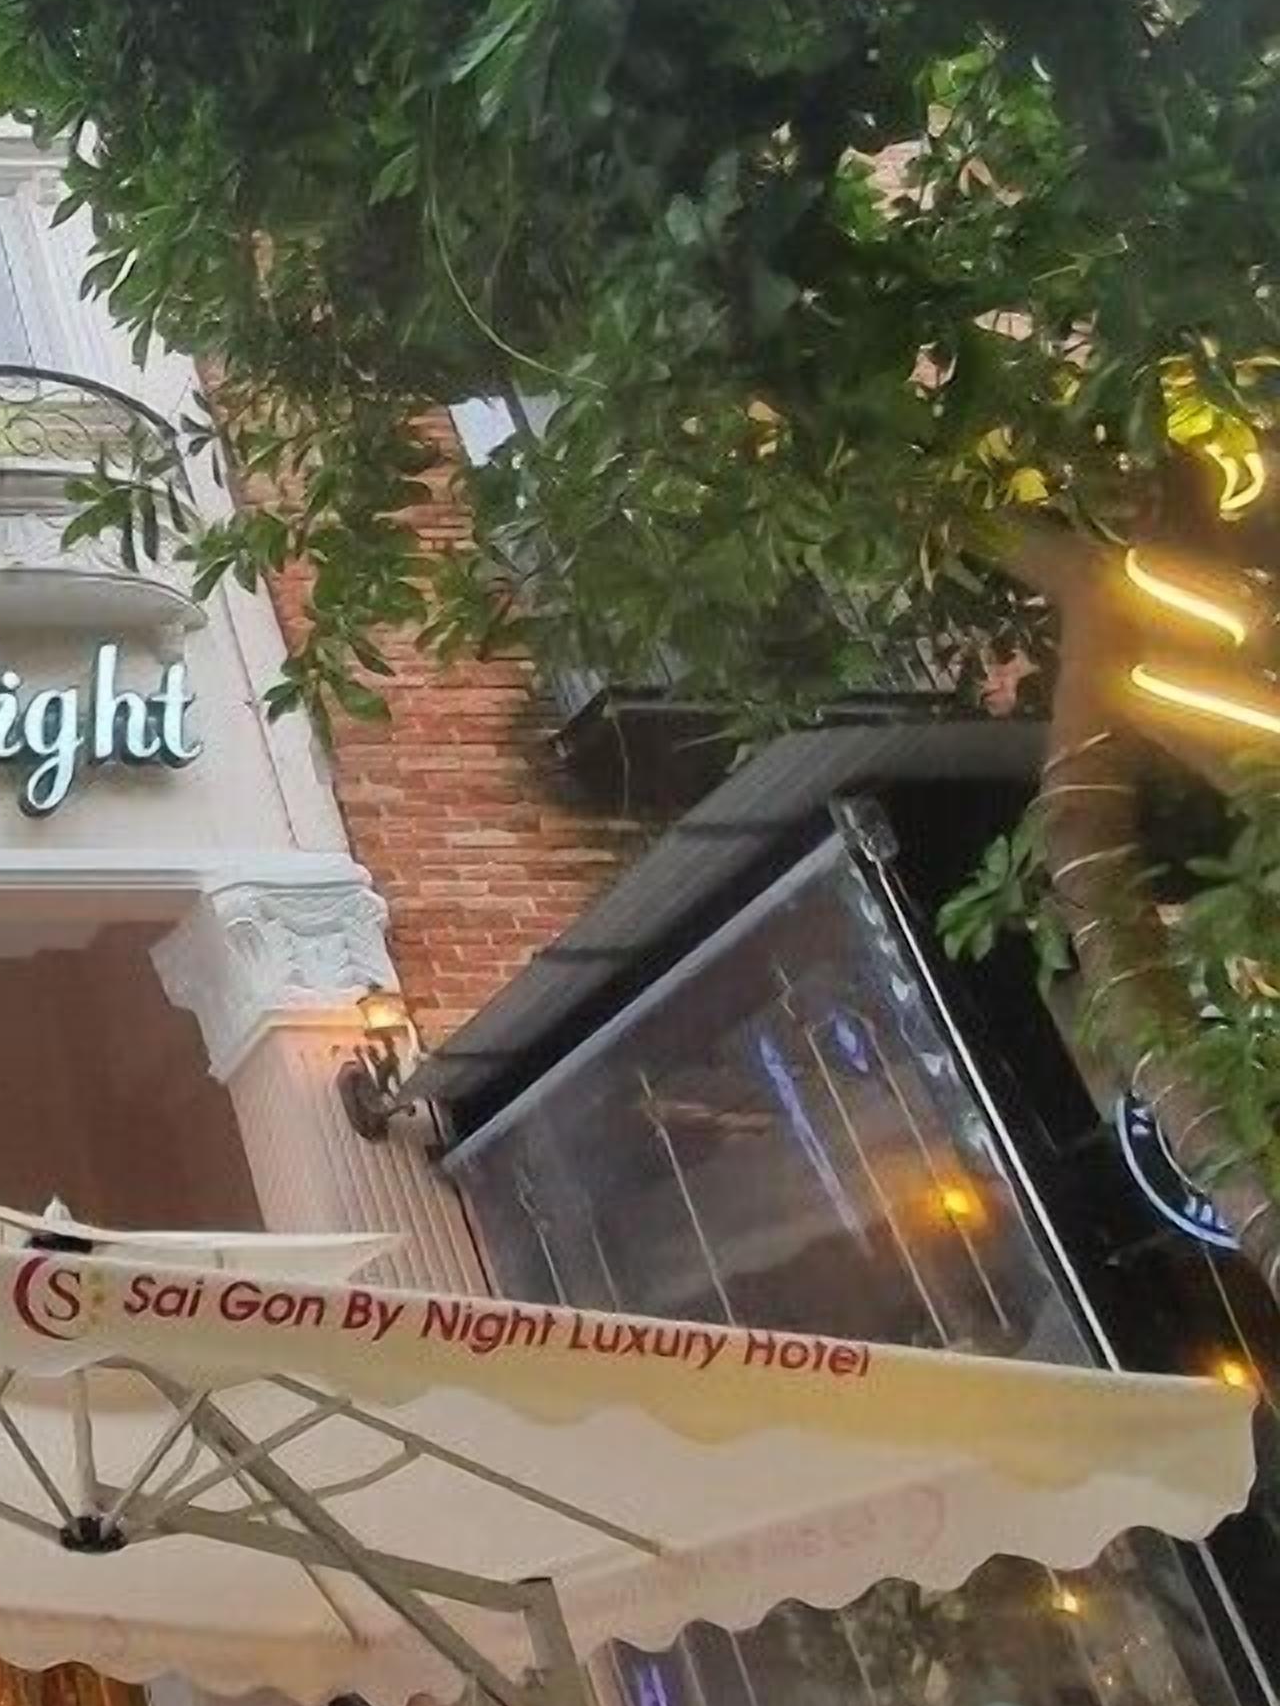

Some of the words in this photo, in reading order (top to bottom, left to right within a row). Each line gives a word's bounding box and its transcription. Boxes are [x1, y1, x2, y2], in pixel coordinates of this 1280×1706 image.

[123, 1275, 206, 1319] Sai
[218, 1281, 326, 1327] Gon
[343, 1290, 405, 1342] By
[420, 1300, 556, 1355] Night
[567, 1315, 729, 1369] Luxury
[743, 1329, 871, 1378] Hotel
